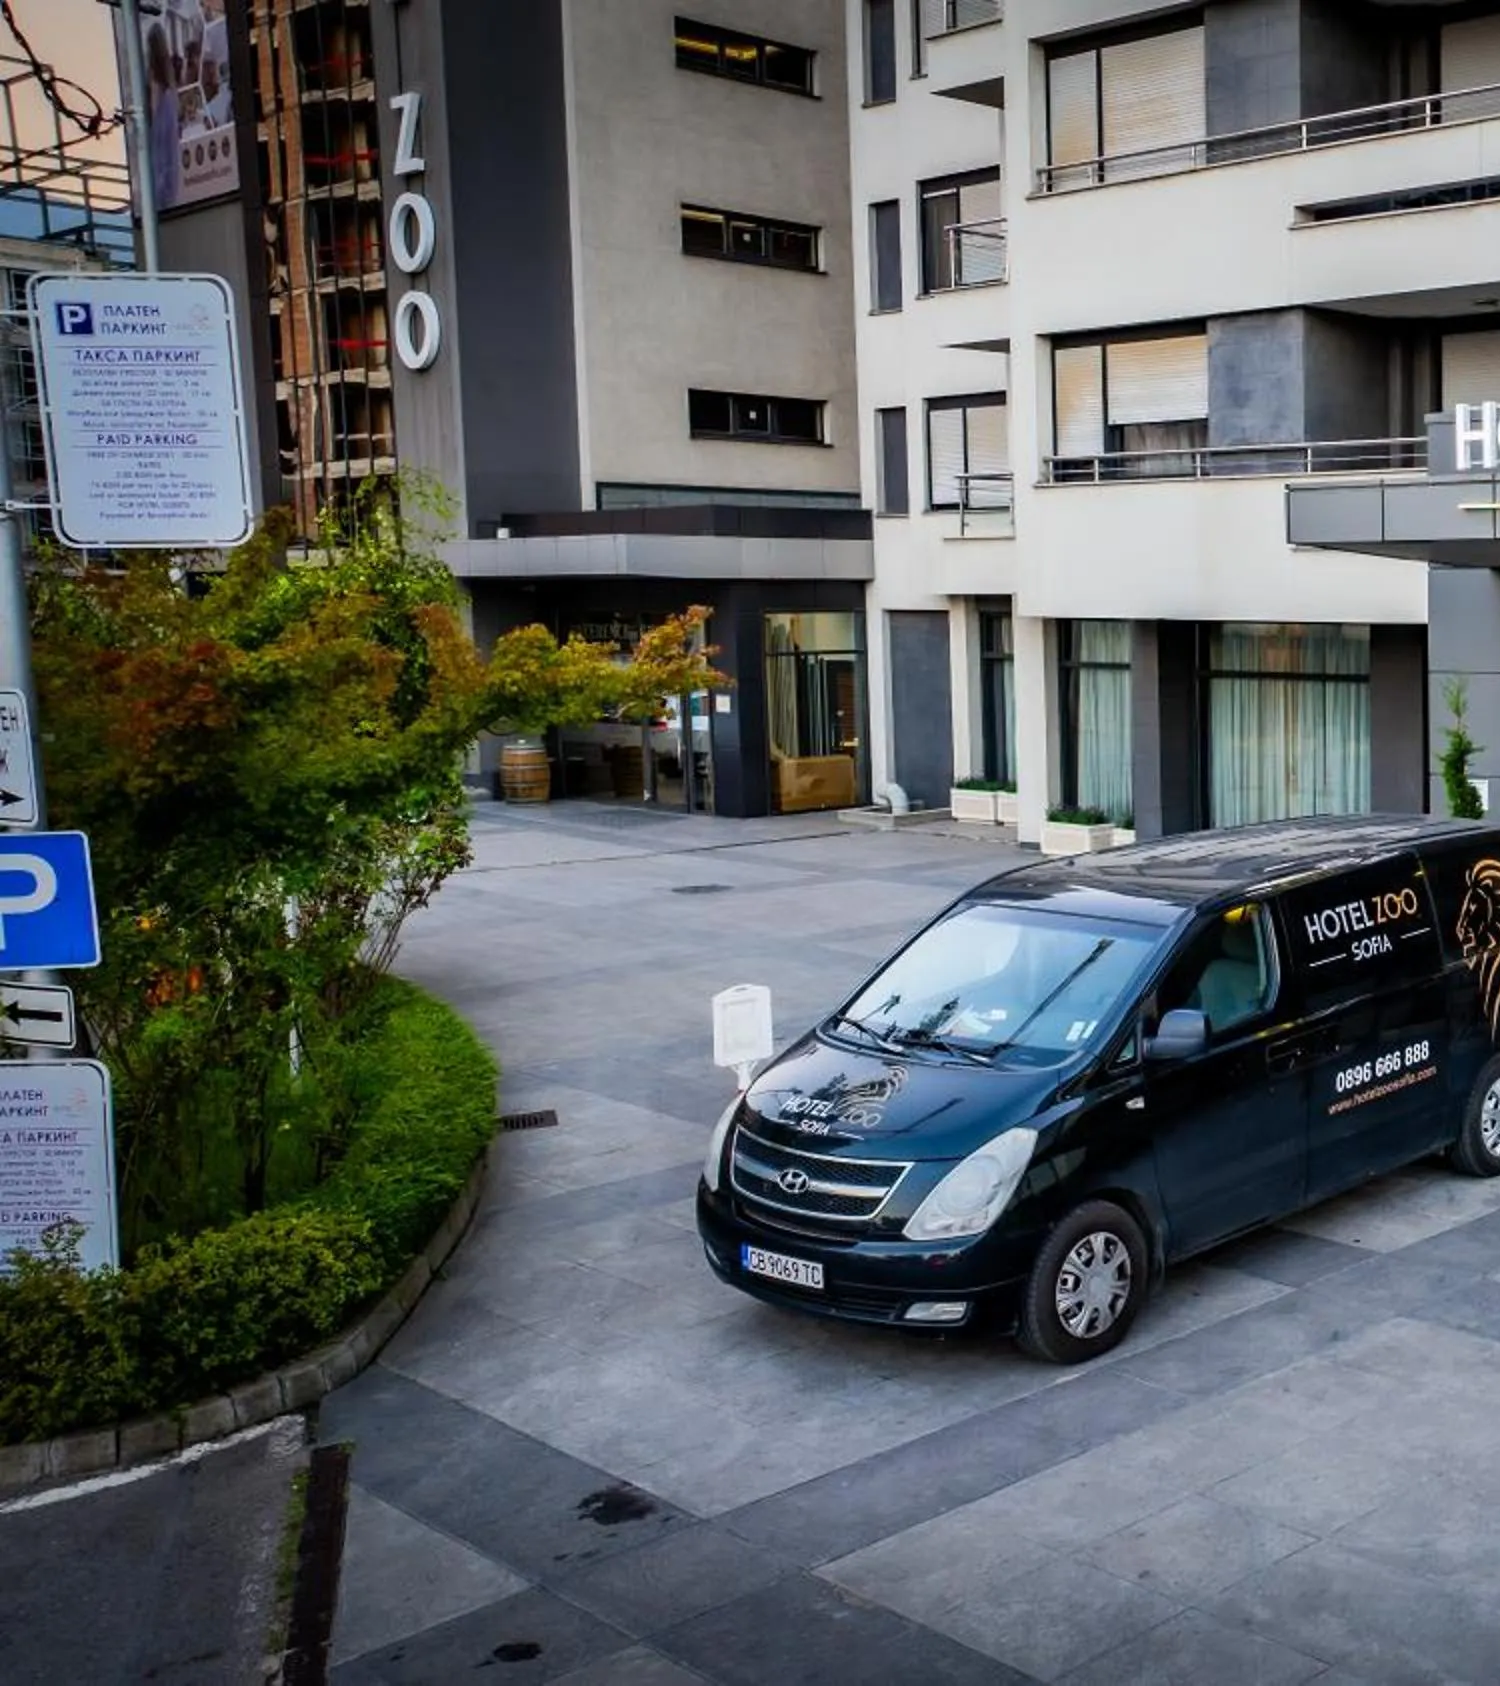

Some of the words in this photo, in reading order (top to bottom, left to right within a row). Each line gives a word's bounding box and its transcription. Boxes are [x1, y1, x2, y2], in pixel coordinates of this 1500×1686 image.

[390, 92, 440, 369] ZOO
[61, 305, 87, 333] P
[103, 305, 160, 317] ПЛАТЕН
[101, 322, 167, 335] ПАРКИНГ
[75, 350, 128, 362] ТАКСА
[133, 350, 201, 362] ПАРКИНГ
[97, 433, 131, 445] PAID
[135, 433, 199, 445] PARKING
[0, 853, 57, 950] P
[1351, 933, 1393, 961] SOFIA
[1335, 1061, 1373, 1093] 0896
[1375, 1051, 1402, 1078] 666
[1404, 1039, 1430, 1067] 888
[0, 1089, 43, 1101] ЛАТЕН
[0, 1105, 48, 1117] АРКИНГ
[779, 1094, 834, 1117] HOTEL
[838, 1106, 881, 1129] ZOO
[800, 1119, 831, 1136] SOFIA
[17, 1131, 79, 1143] ПАРКИНГ
[768, 1255, 800, 1281] 9069
[802, 1263, 821, 1285] TC
